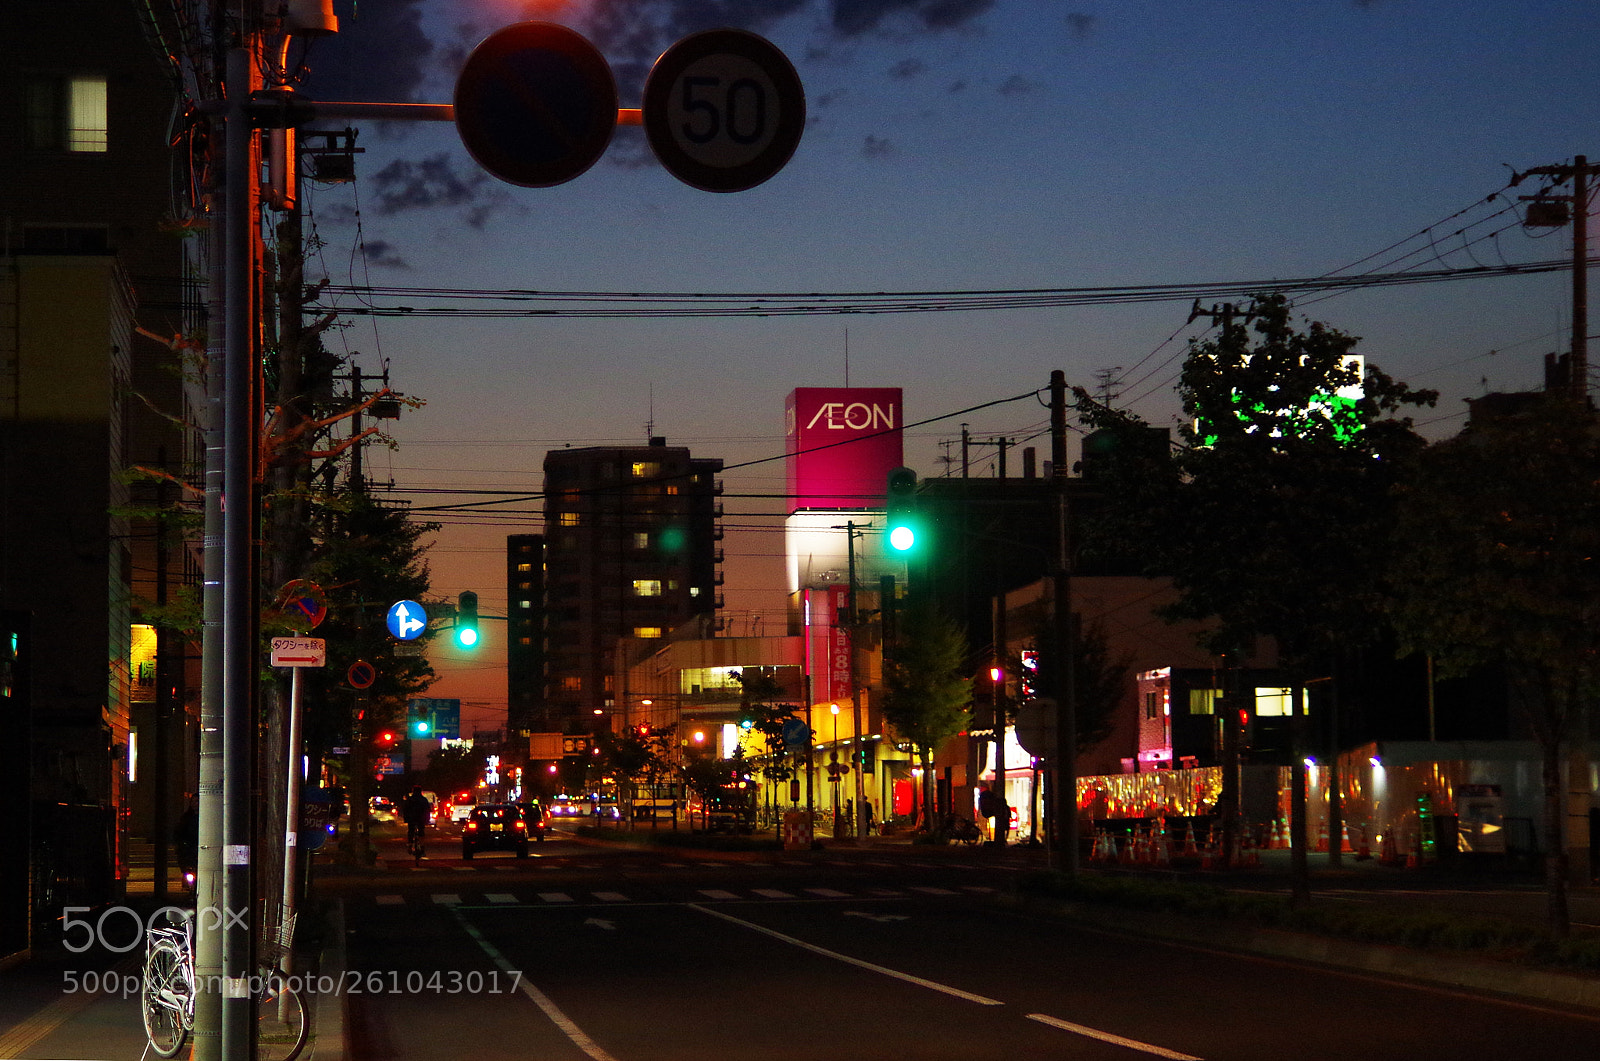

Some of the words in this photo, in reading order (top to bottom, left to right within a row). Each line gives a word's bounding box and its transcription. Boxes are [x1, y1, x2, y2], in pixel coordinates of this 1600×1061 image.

[682, 76, 766, 144] 50
[272, 639, 324, 650] タクシーを除く
